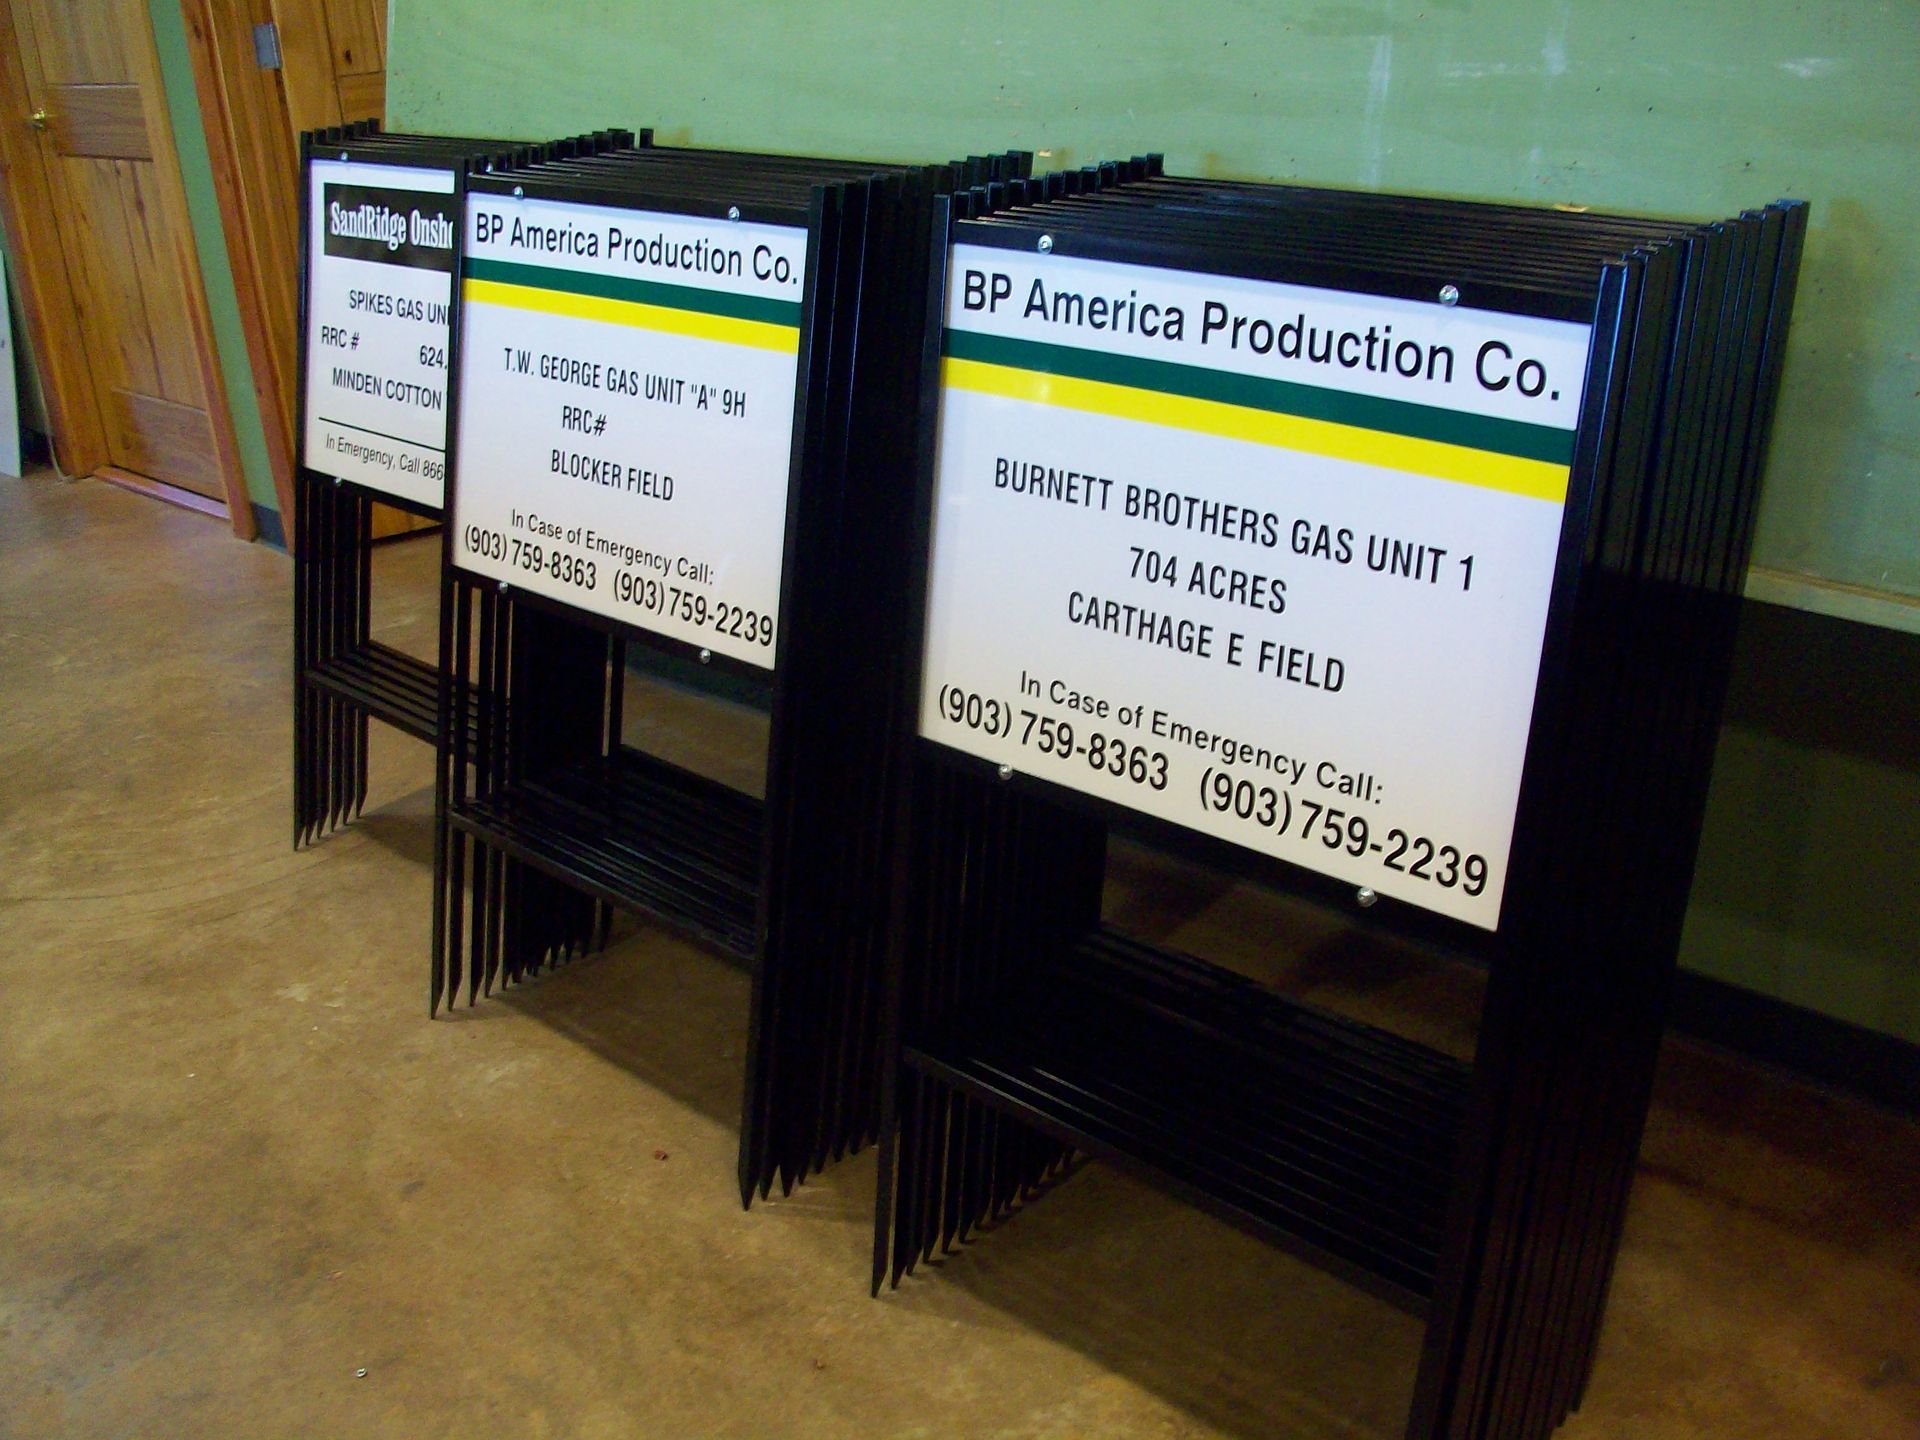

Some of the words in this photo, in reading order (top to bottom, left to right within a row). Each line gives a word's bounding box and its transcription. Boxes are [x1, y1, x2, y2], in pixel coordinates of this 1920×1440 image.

[330, 200, 407, 251] SandRidge
[476, 213, 503, 244] BP
[510, 216, 599, 258] America
[608, 228, 743, 277] Production
[752, 245, 798, 285] Co.
[321, 325, 347, 350] RRC
[350, 332, 360, 350] #
[349, 289, 393, 317] SPIKES
[397, 298, 423, 321] GAS
[963, 269, 1013, 313] BP
[1023, 279, 1184, 341] America
[1201, 301, 1454, 384] Production
[1475, 340, 1562, 402] Co.
[332, 367, 382, 397] MINDEN
[385, 381, 442, 411] COTTON
[504, 348, 534, 376] T.W.
[540, 354, 601, 388] GEORGE
[607, 367, 639, 396] GAS
[645, 374, 685, 405] UNIT
[691, 384, 717, 411] "A"
[723, 390, 746, 418] 9H
[326, 433, 335, 450] In
[337, 437, 396, 470] Emergency,
[399, 453, 420, 474] Call
[551, 449, 622, 488] BLOCKER
[627, 468, 673, 501] FIELD
[512, 509, 524, 528] In
[528, 513, 563, 540] Case
[567, 527, 583, 546] of
[587, 531, 672, 577] Emergency
[677, 558, 714, 585] Call:
[994, 457, 1114, 511] BURNETT
[1125, 485, 1279, 548] BROTHERS
[1291, 519, 1354, 566] GAS
[1368, 538, 1448, 586] UNIT
[1458, 554, 1476, 592] 1
[1129, 546, 1179, 586] 704
[1188, 562, 1288, 616] ACRES
[1067, 590, 1214, 658] CARTHAGE
[1227, 633, 1244, 667] E
[1257, 640, 1346, 693] FIELD
[1020, 670, 1041, 698] In
[1049, 680, 1110, 719] Case
[1118, 702, 1145, 730] of
[1151, 711, 1307, 785] Emergency
[1316, 761, 1384, 805] Call:
